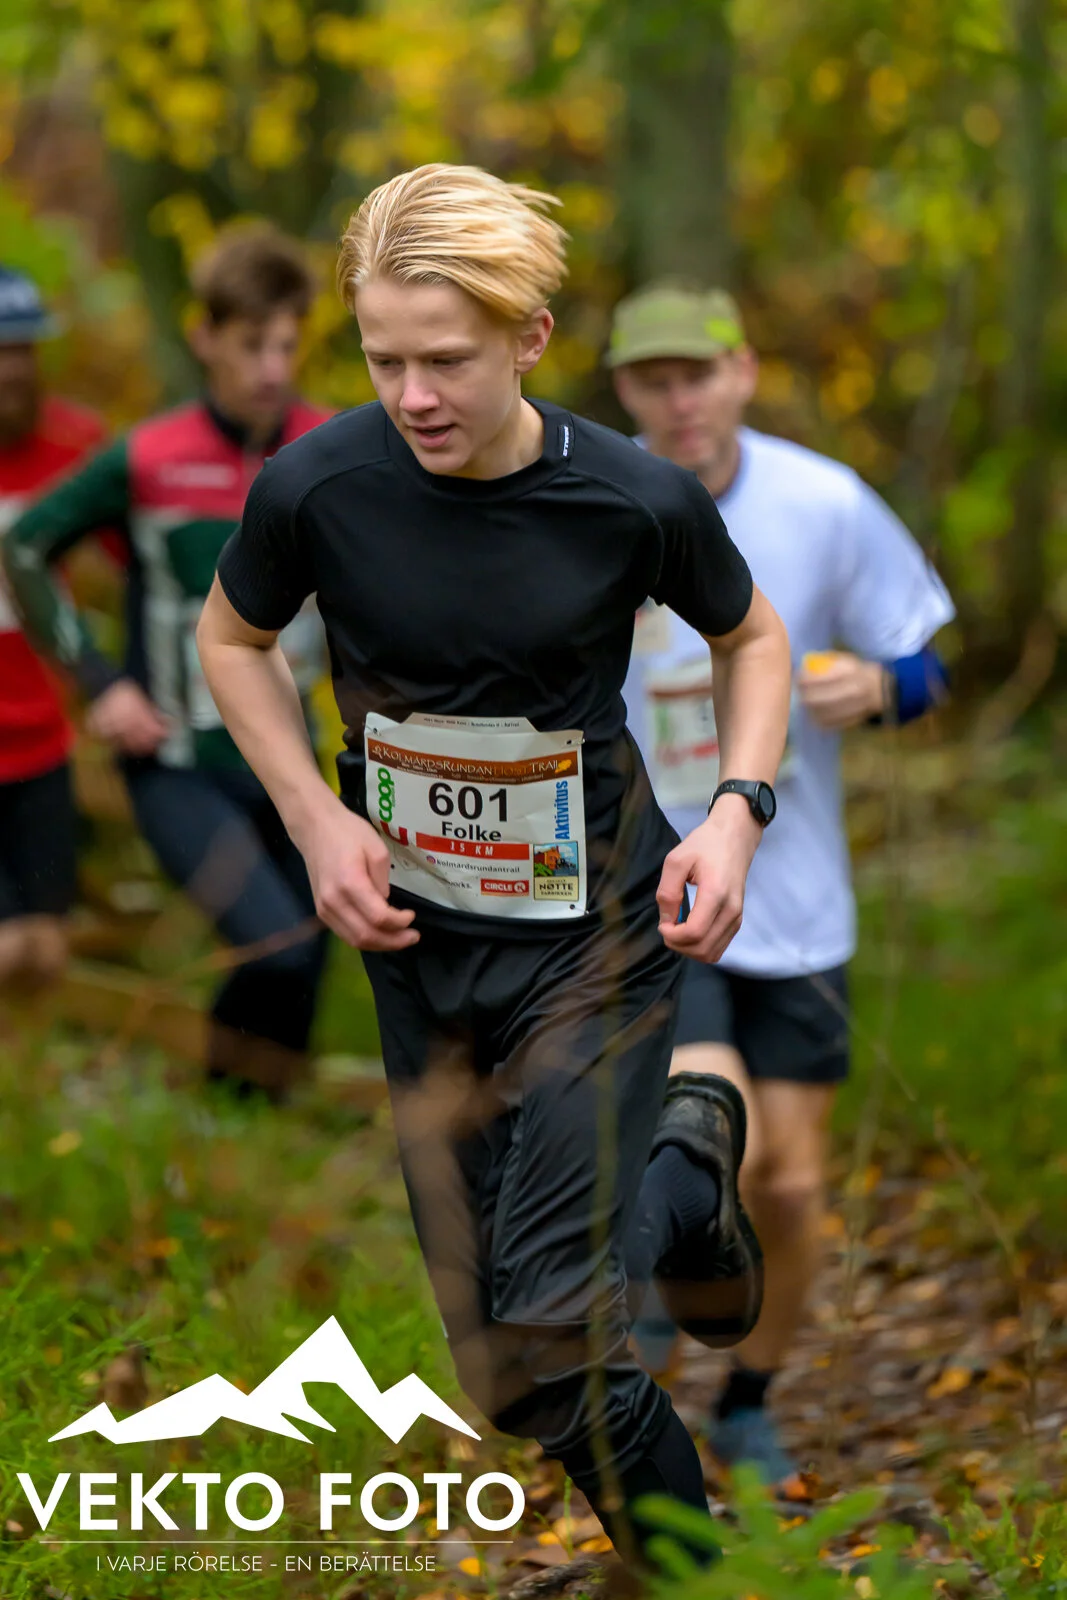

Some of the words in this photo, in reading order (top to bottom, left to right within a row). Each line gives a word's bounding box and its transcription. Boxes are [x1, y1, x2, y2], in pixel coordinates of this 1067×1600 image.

[428, 782, 508, 822] 601
[554, 780, 570, 840] Aktivitus
[441, 821, 502, 842] Folke
[450, 841, 466, 853] 15
[475, 845, 494, 857] KM
[484, 882, 513, 892] CIRCLE
